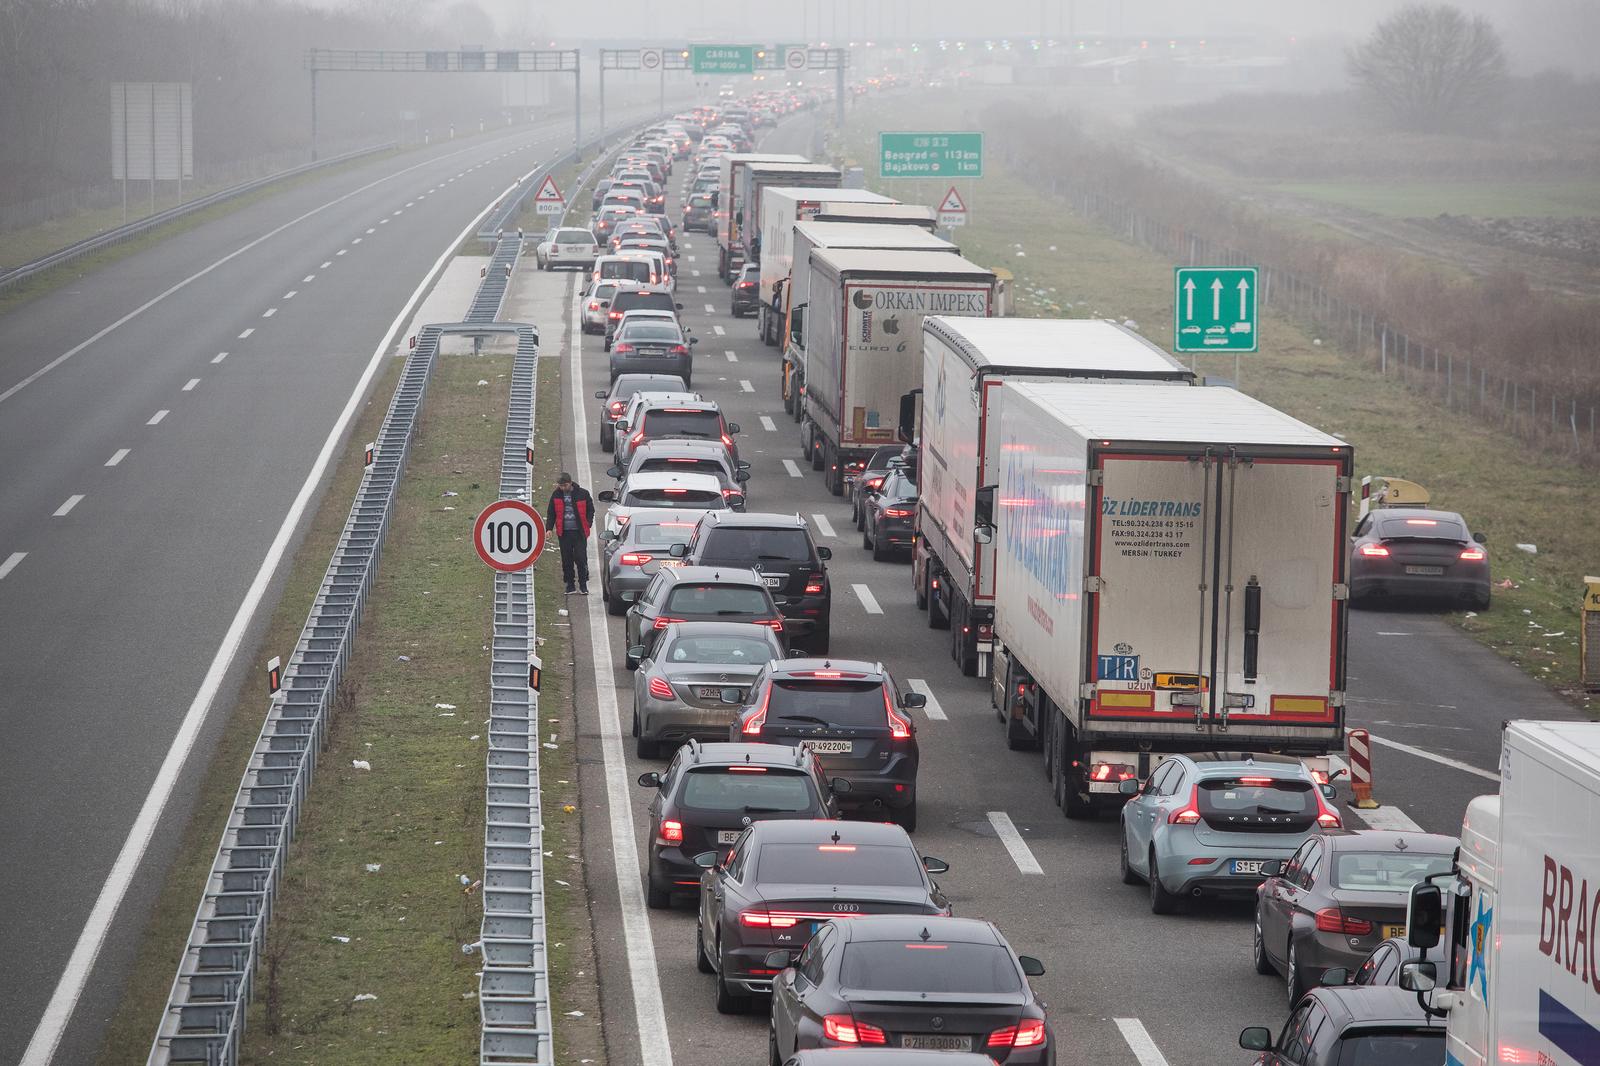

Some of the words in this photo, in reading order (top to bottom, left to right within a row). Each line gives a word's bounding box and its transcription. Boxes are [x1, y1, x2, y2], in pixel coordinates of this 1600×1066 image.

[884, 150, 927, 161] Beograd
[944, 150, 962, 159] 113
[963, 151, 978, 159] km
[884, 162, 929, 173] Bajakovo
[963, 162, 978, 170] km
[538, 204, 553, 212] 800
[875, 290, 926, 310] ORKAN
[930, 292, 985, 312] IMPEKS
[1392, 489, 1400, 498] 3
[1120, 498, 1202, 517] LİDERTRANS
[487, 521, 532, 553] 100
[1175, 531, 1184, 539] 17
[1154, 550, 1183, 558] TURKEY
[1101, 657, 1135, 679] TIR
[1127, 682, 1153, 690] UZUN
